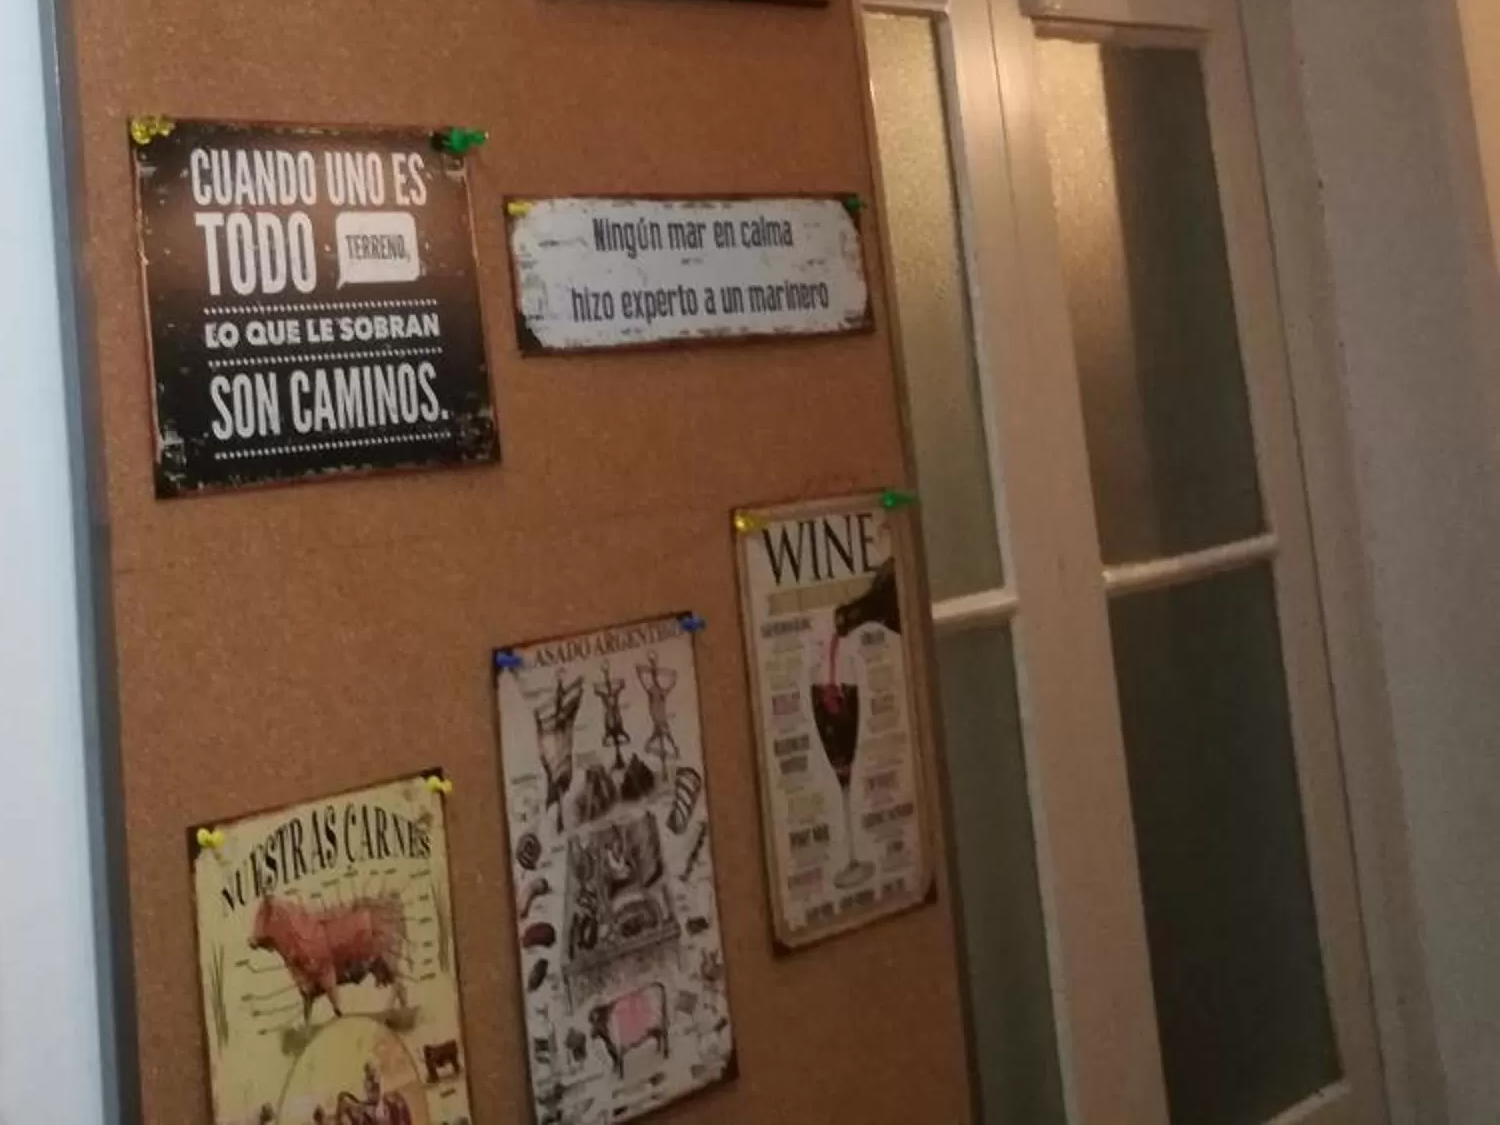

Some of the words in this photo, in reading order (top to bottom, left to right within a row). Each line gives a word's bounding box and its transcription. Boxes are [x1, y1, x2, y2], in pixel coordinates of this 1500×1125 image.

[189, 148, 317, 206] CUANDO
[324, 151, 385, 206] UNO
[390, 152, 428, 207] ES
[194, 210, 318, 296] TODO
[591, 216, 664, 260] Ningún
[667, 221, 708, 252] mar
[712, 219, 738, 249] en
[741, 216, 795, 248] calma
[204, 322, 239, 349] LO
[245, 318, 301, 347] QUE
[306, 317, 334, 344] LE
[340, 312, 442, 342] SOBRAN
[570, 285, 616, 324] hizo
[621, 284, 700, 327] experto
[703, 290, 717, 316] a
[720, 286, 745, 316] un
[748, 280, 831, 314] marinero
[209, 371, 282, 441] SON
[288, 360, 450, 435] CAMINOS.
[760, 513, 878, 587] WINE
[534, 639, 592, 667] ASADO
[343, 802, 432, 863] CARNES
